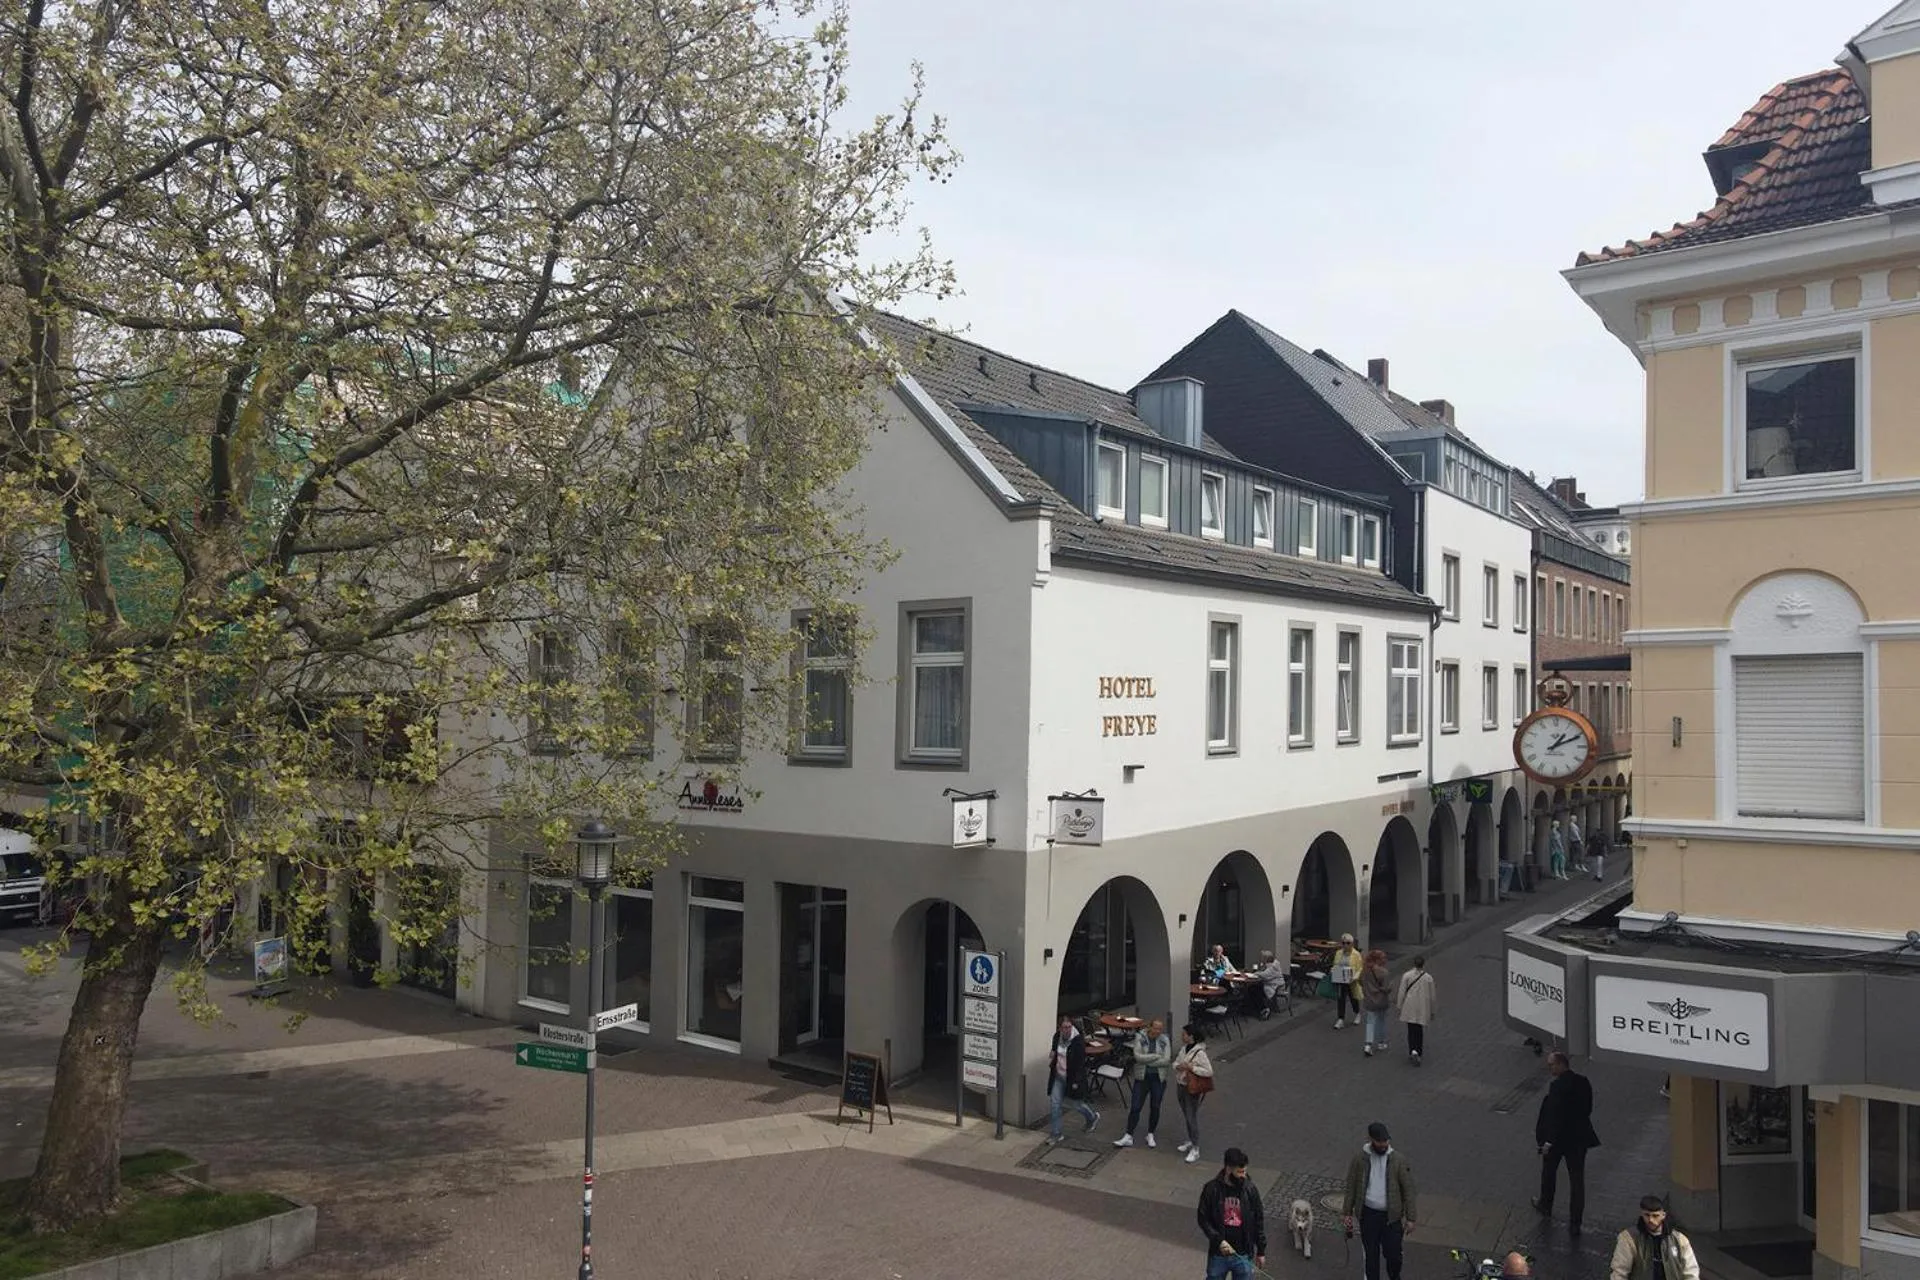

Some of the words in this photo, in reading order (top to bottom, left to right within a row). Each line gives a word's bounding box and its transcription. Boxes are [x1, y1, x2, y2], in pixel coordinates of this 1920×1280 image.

[1099, 676, 1157, 699] HOTEL
[1102, 714, 1157, 737] FREYE
[972, 984, 990, 994] ZONE
[1510, 970, 1563, 1003] LONGINES
[597, 1007, 636, 1028] Emsstraße
[543, 1027, 585, 1045] Klosterstraße
[1612, 1015, 1750, 1046] BREITLING
[1669, 1037, 1691, 1046] 1884
